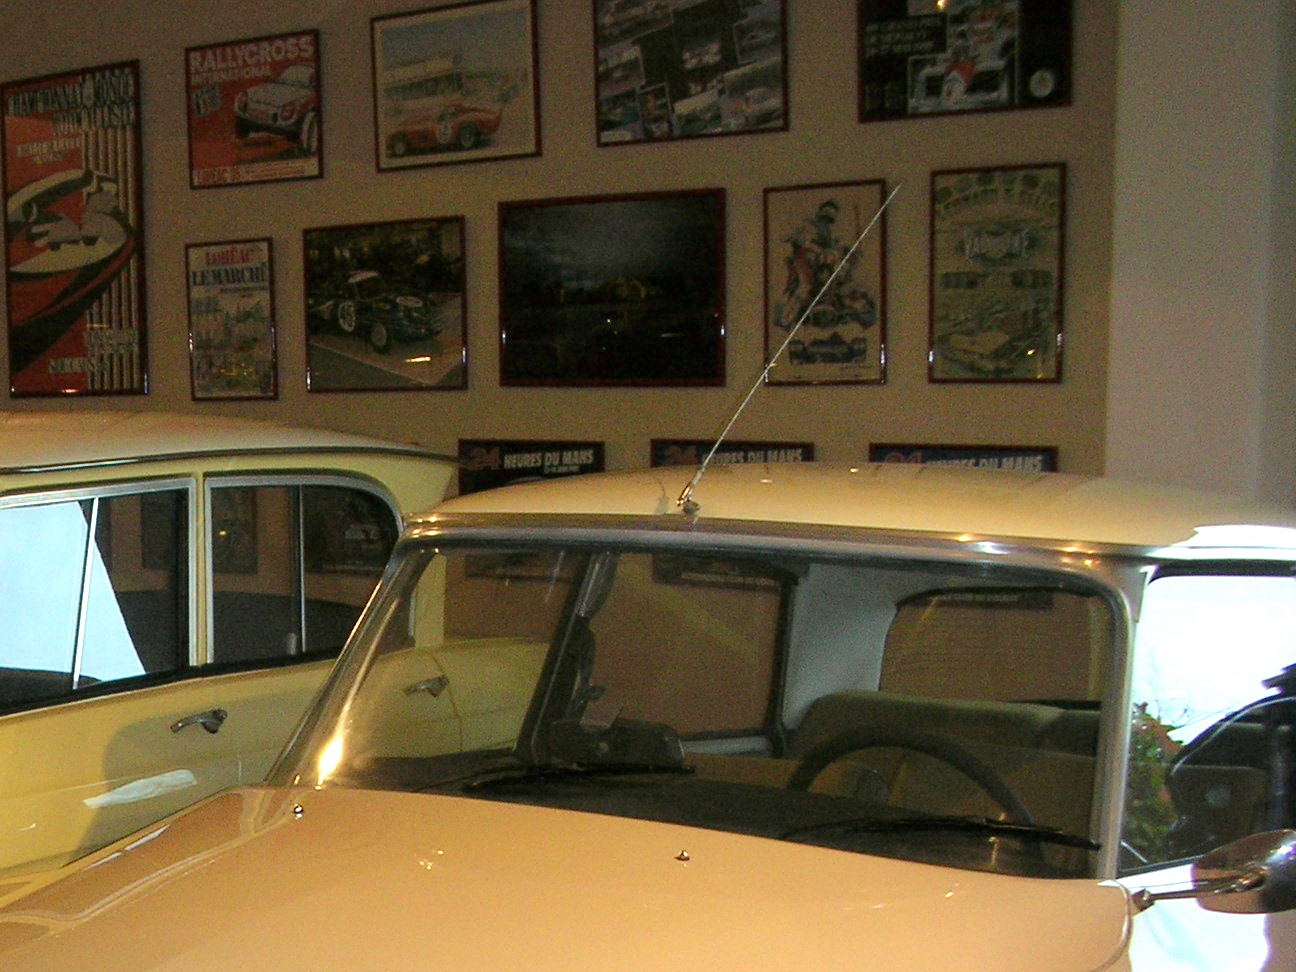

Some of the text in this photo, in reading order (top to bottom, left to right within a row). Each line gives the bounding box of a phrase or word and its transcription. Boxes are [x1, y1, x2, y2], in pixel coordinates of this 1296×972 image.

[189, 35, 315, 74] RALLYCROSS
[504, 452, 543, 470] HEURES
[544, 450, 561, 466] DU
[562, 448, 595, 465] MANS
[767, 447, 803, 463] MANS
